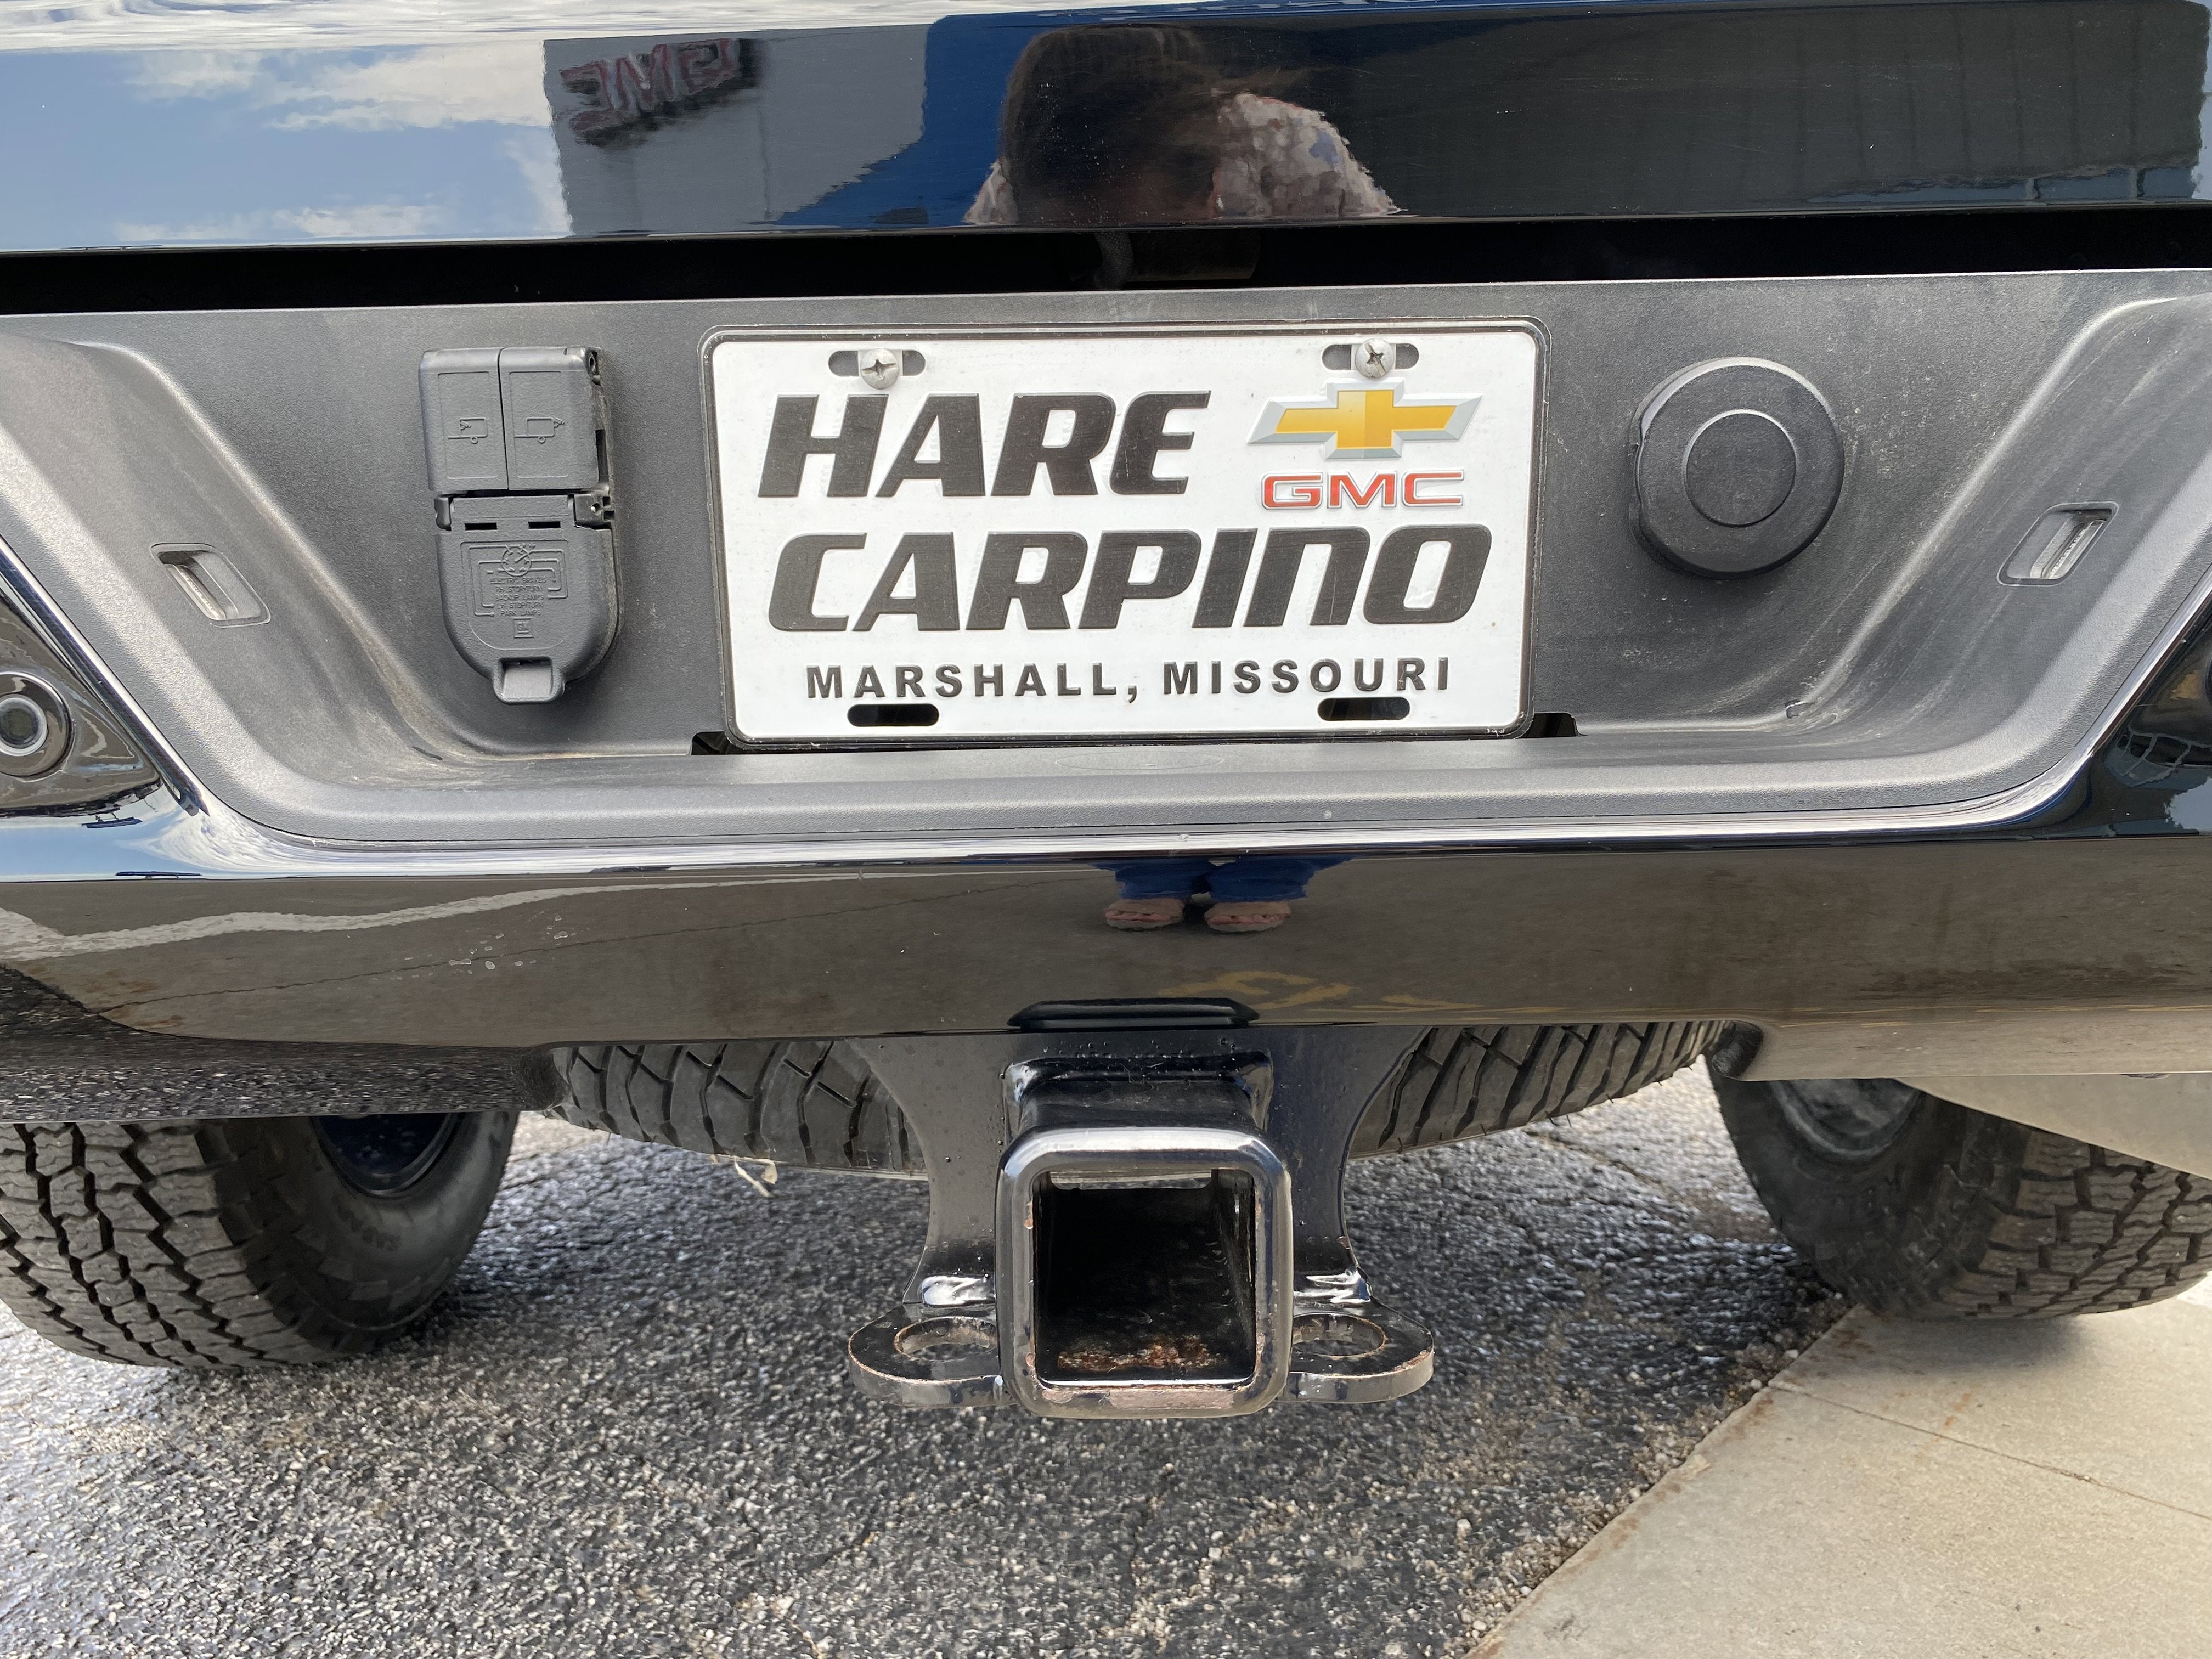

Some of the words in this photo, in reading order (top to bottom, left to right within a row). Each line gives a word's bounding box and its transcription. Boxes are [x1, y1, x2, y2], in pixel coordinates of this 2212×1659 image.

[757, 390, 1211, 498] HARE
[1261, 469, 1465, 510] GMC
[522, 575, 547, 584] BRAKES
[523, 592, 544, 601] LAMPS
[768, 524, 1492, 632] CARPINO
[805, 662, 1137, 703] MARSHALL,
[1163, 657, 1449, 696] MISSOURI
